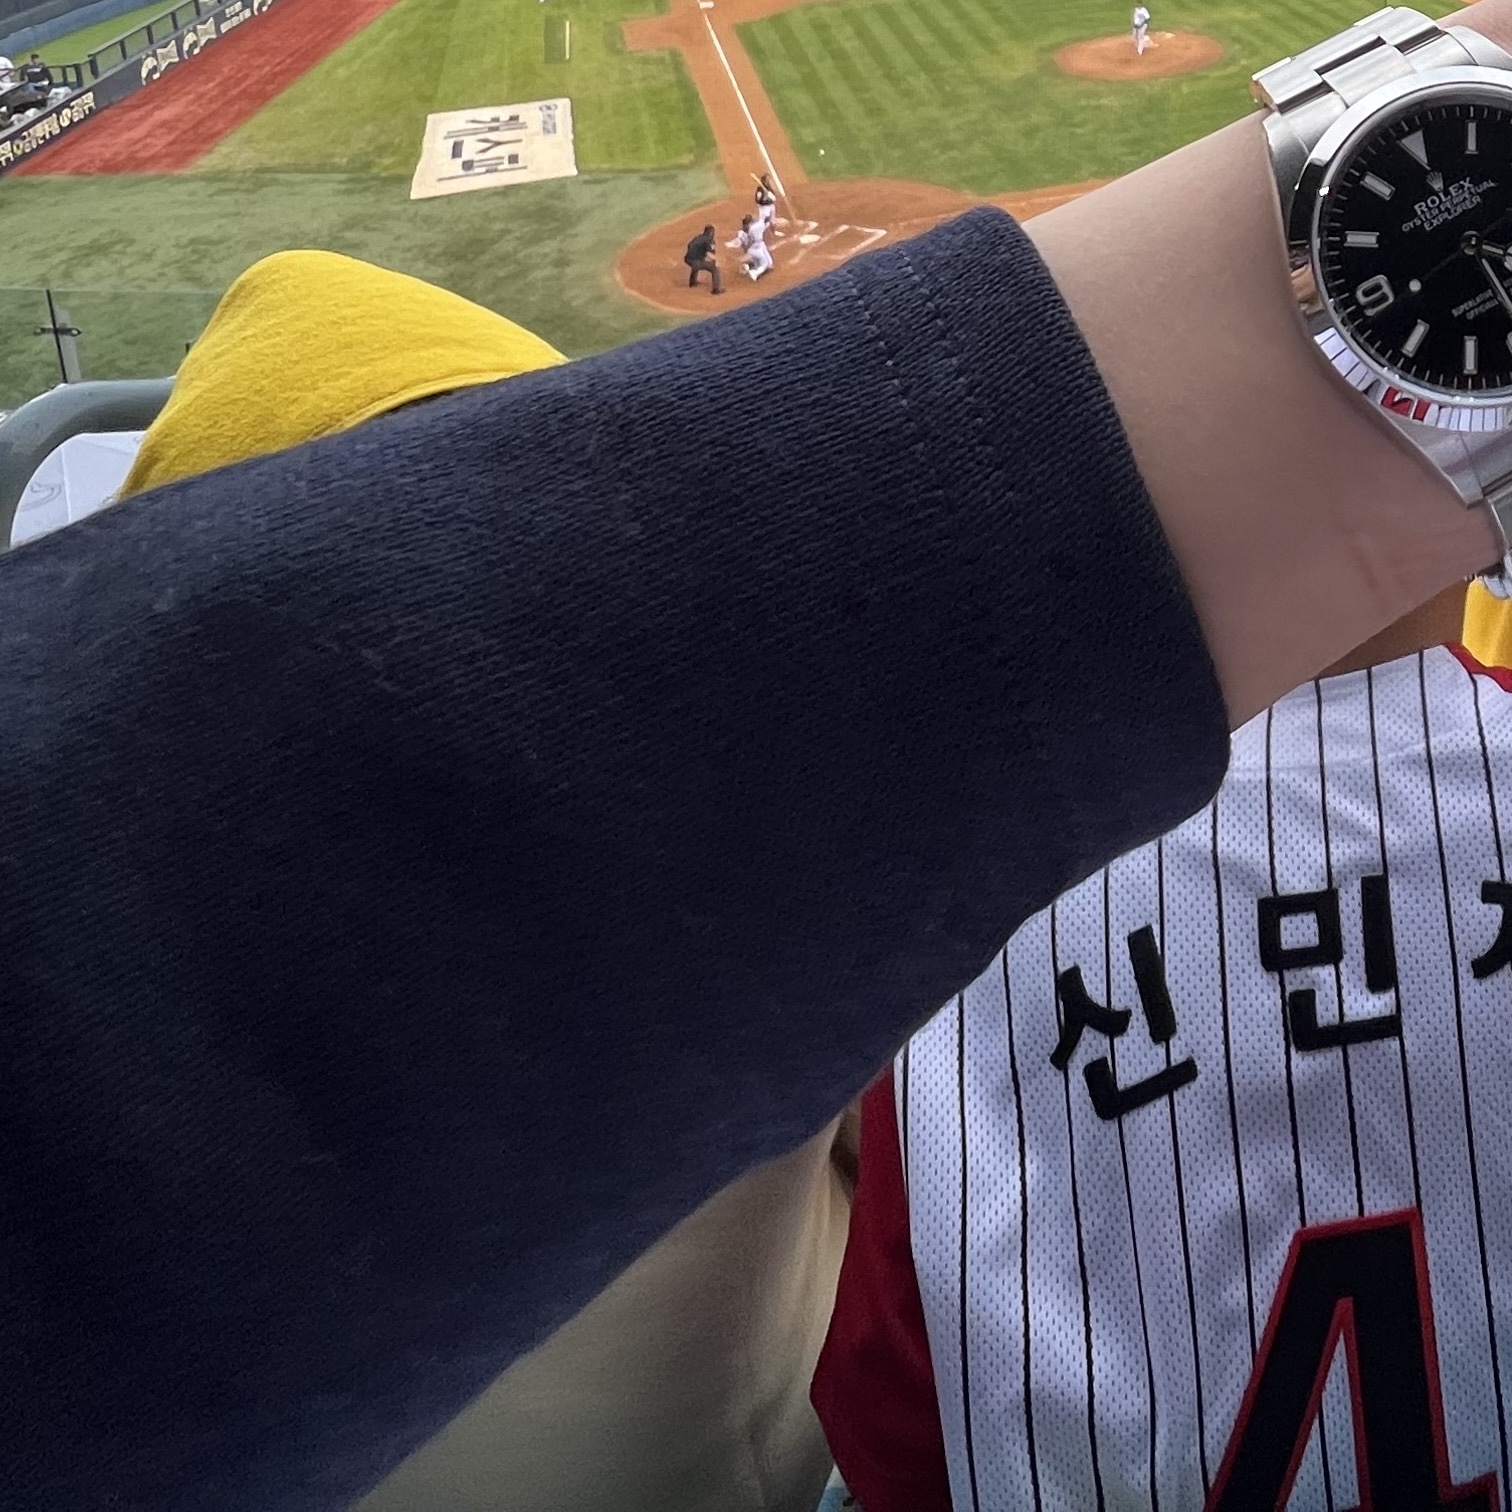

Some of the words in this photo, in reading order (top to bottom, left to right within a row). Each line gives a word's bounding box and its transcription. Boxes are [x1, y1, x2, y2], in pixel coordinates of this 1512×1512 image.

[1413, 176, 1474, 216] ROLEX
[1423, 194, 1483, 231] EXPLORER
[1401, 208, 1440, 233] OYSTER
[1354, 274, 1395, 317] 9
[1197, 1206, 1500, 1512] 4
